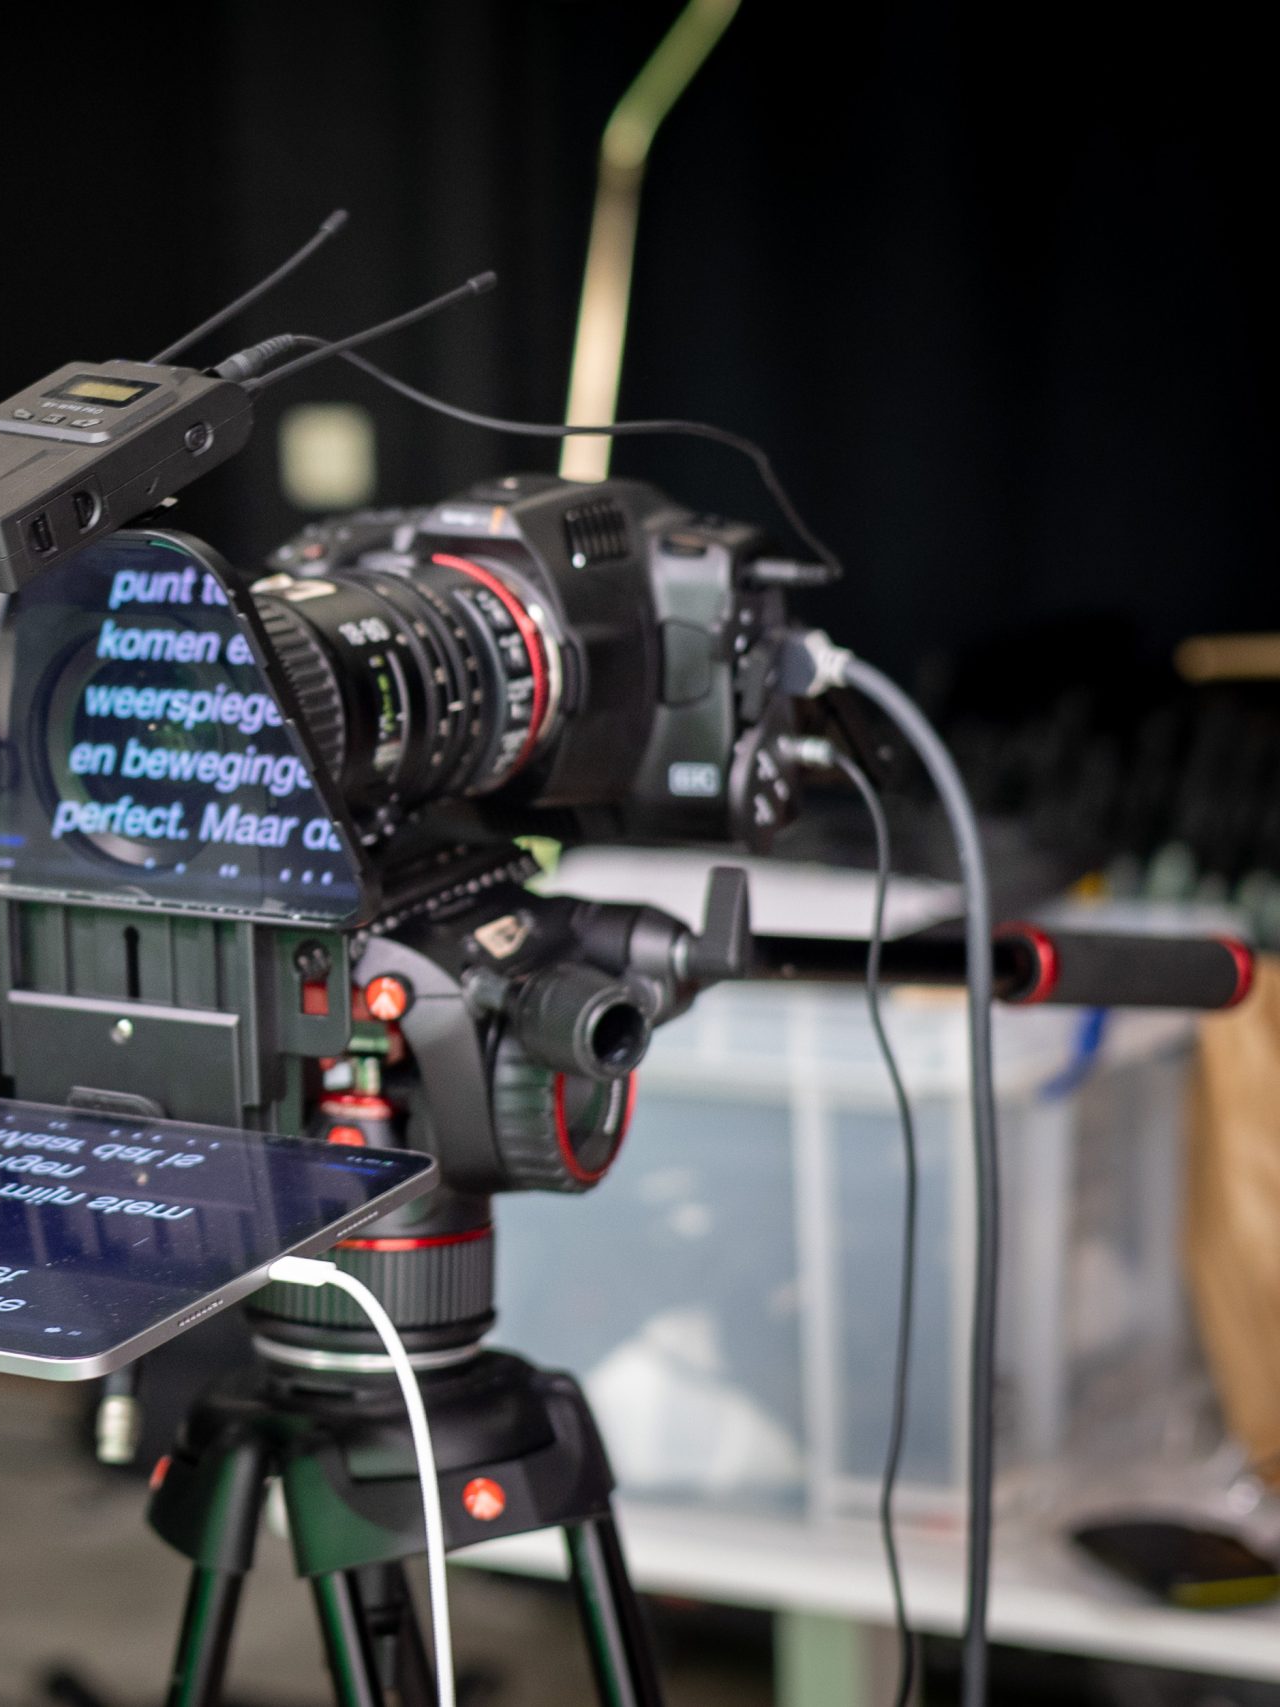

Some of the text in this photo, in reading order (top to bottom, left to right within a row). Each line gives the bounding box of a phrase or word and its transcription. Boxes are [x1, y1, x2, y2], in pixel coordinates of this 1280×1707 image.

[108, 566, 197, 609] punt
[98, 618, 256, 665] komen e
[70, 742, 117, 776] en
[51, 795, 189, 840] perfect.
[199, 801, 299, 848] Maar
